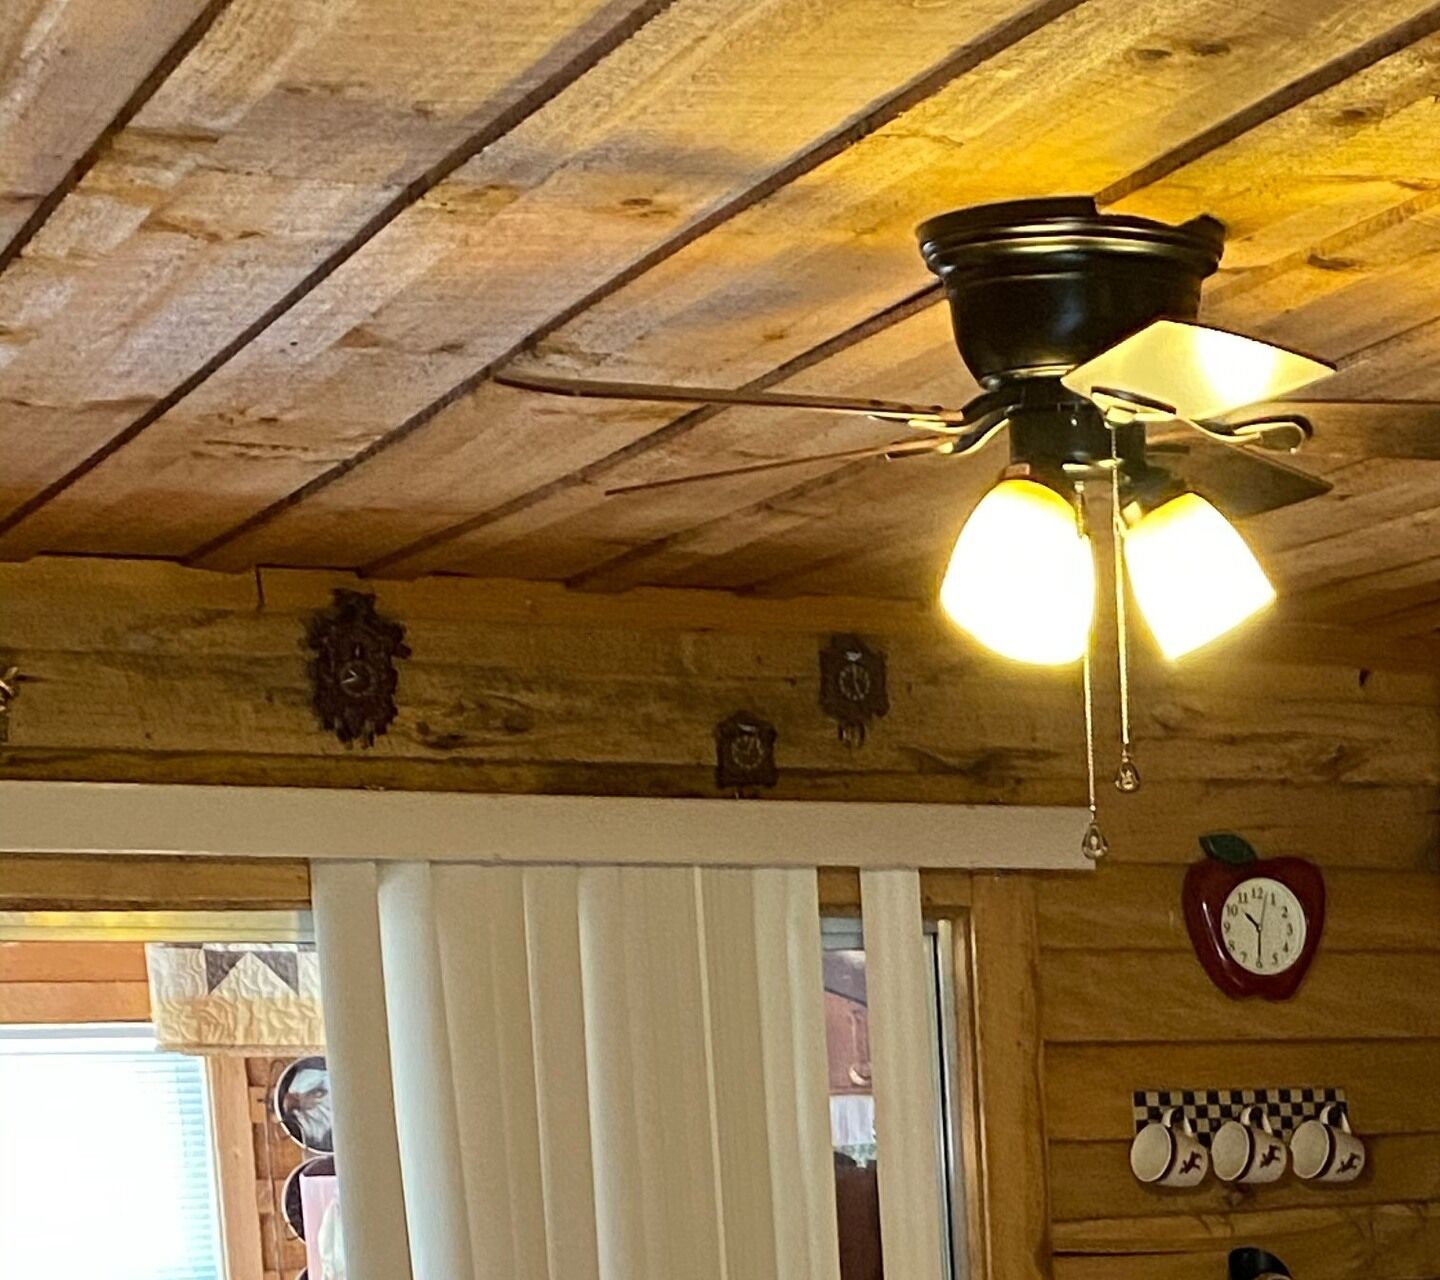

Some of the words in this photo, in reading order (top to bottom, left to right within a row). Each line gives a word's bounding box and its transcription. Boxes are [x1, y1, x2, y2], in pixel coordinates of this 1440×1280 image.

[1238, 892, 1249, 904] 11
[1251, 887, 1264, 899] 12
[1271, 892, 1276, 906] 1
[1226, 904, 1239, 917] 10
[1281, 905, 1288, 918] 2
[1223, 921, 1231, 934] 9
[1271, 952, 1279, 966] 5
